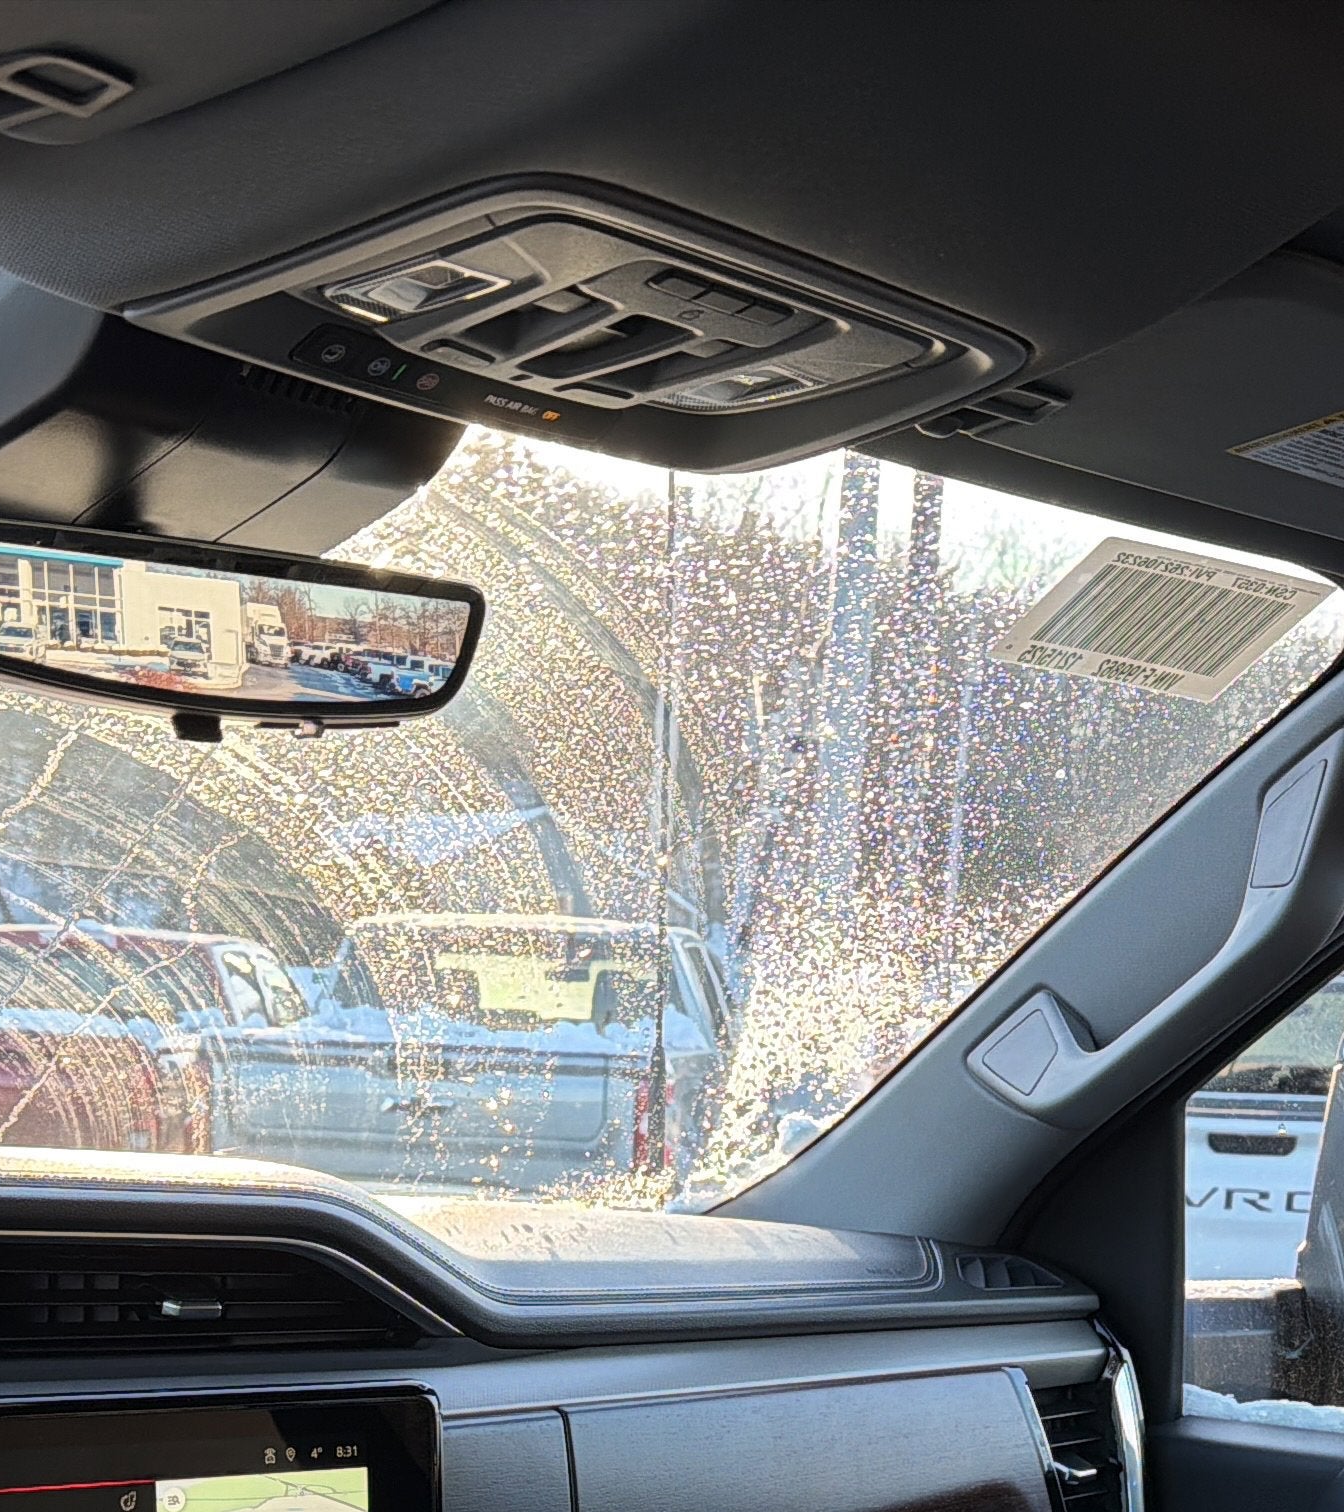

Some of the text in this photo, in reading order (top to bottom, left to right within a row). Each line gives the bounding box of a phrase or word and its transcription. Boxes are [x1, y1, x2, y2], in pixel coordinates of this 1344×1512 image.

[484, 394, 507, 408] PASS
[505, 401, 523, 411] AIR
[335, 1446, 358, 1458] 8:31
